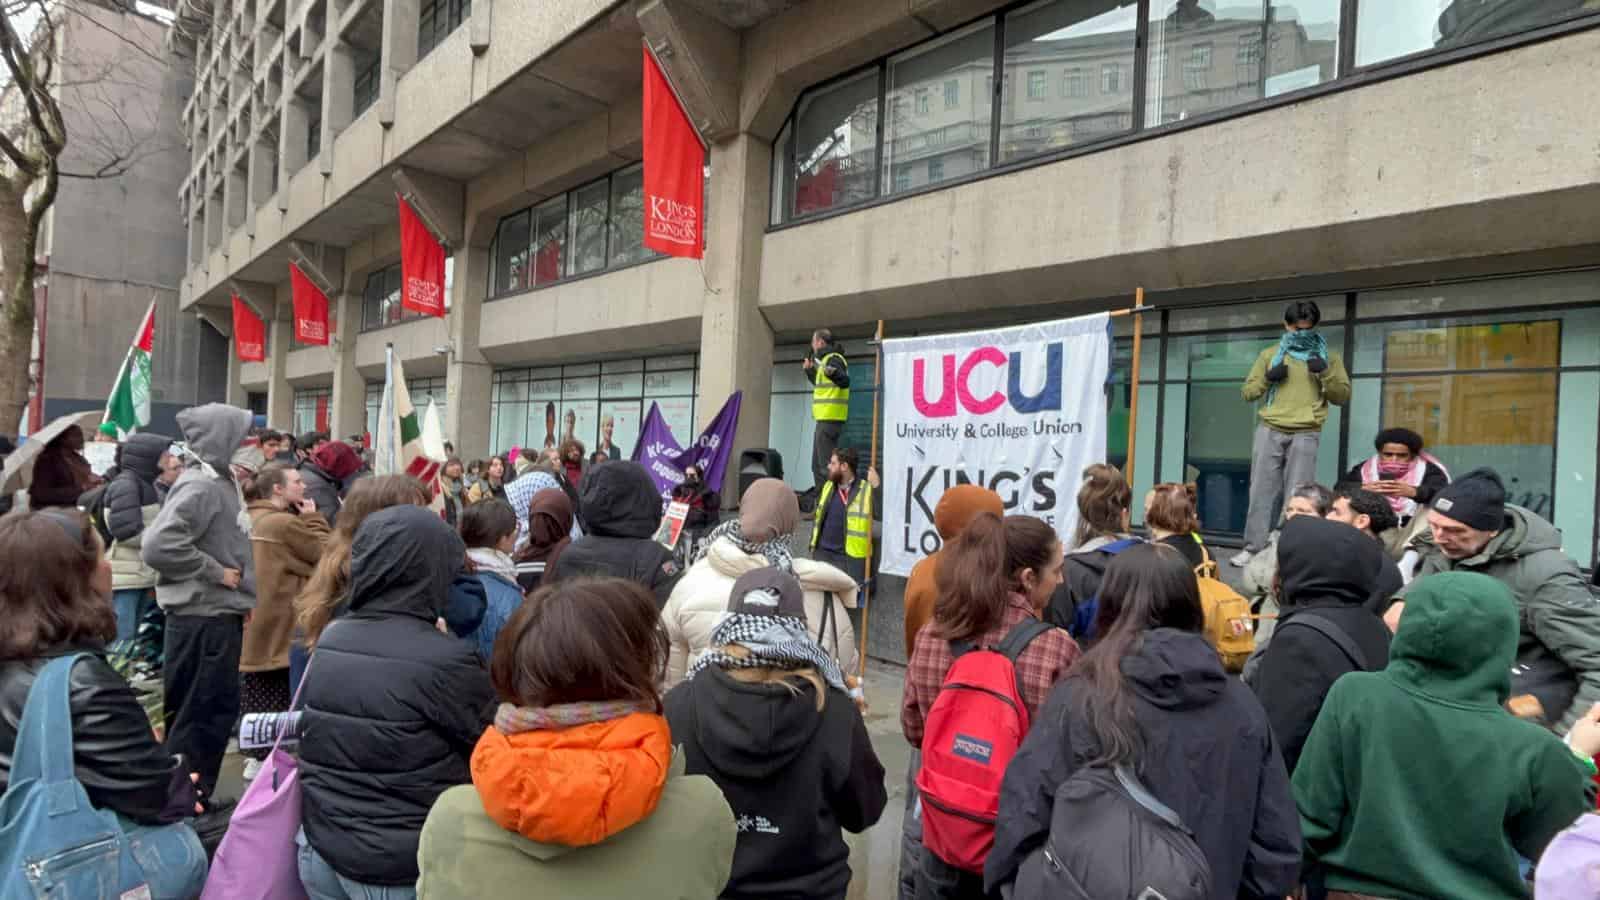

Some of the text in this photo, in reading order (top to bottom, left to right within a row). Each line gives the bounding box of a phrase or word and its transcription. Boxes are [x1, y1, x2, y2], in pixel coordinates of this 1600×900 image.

[649, 194, 697, 221] KING'S
[650, 219, 697, 240] LONDON
[896, 418, 1082, 440] University & College Union
